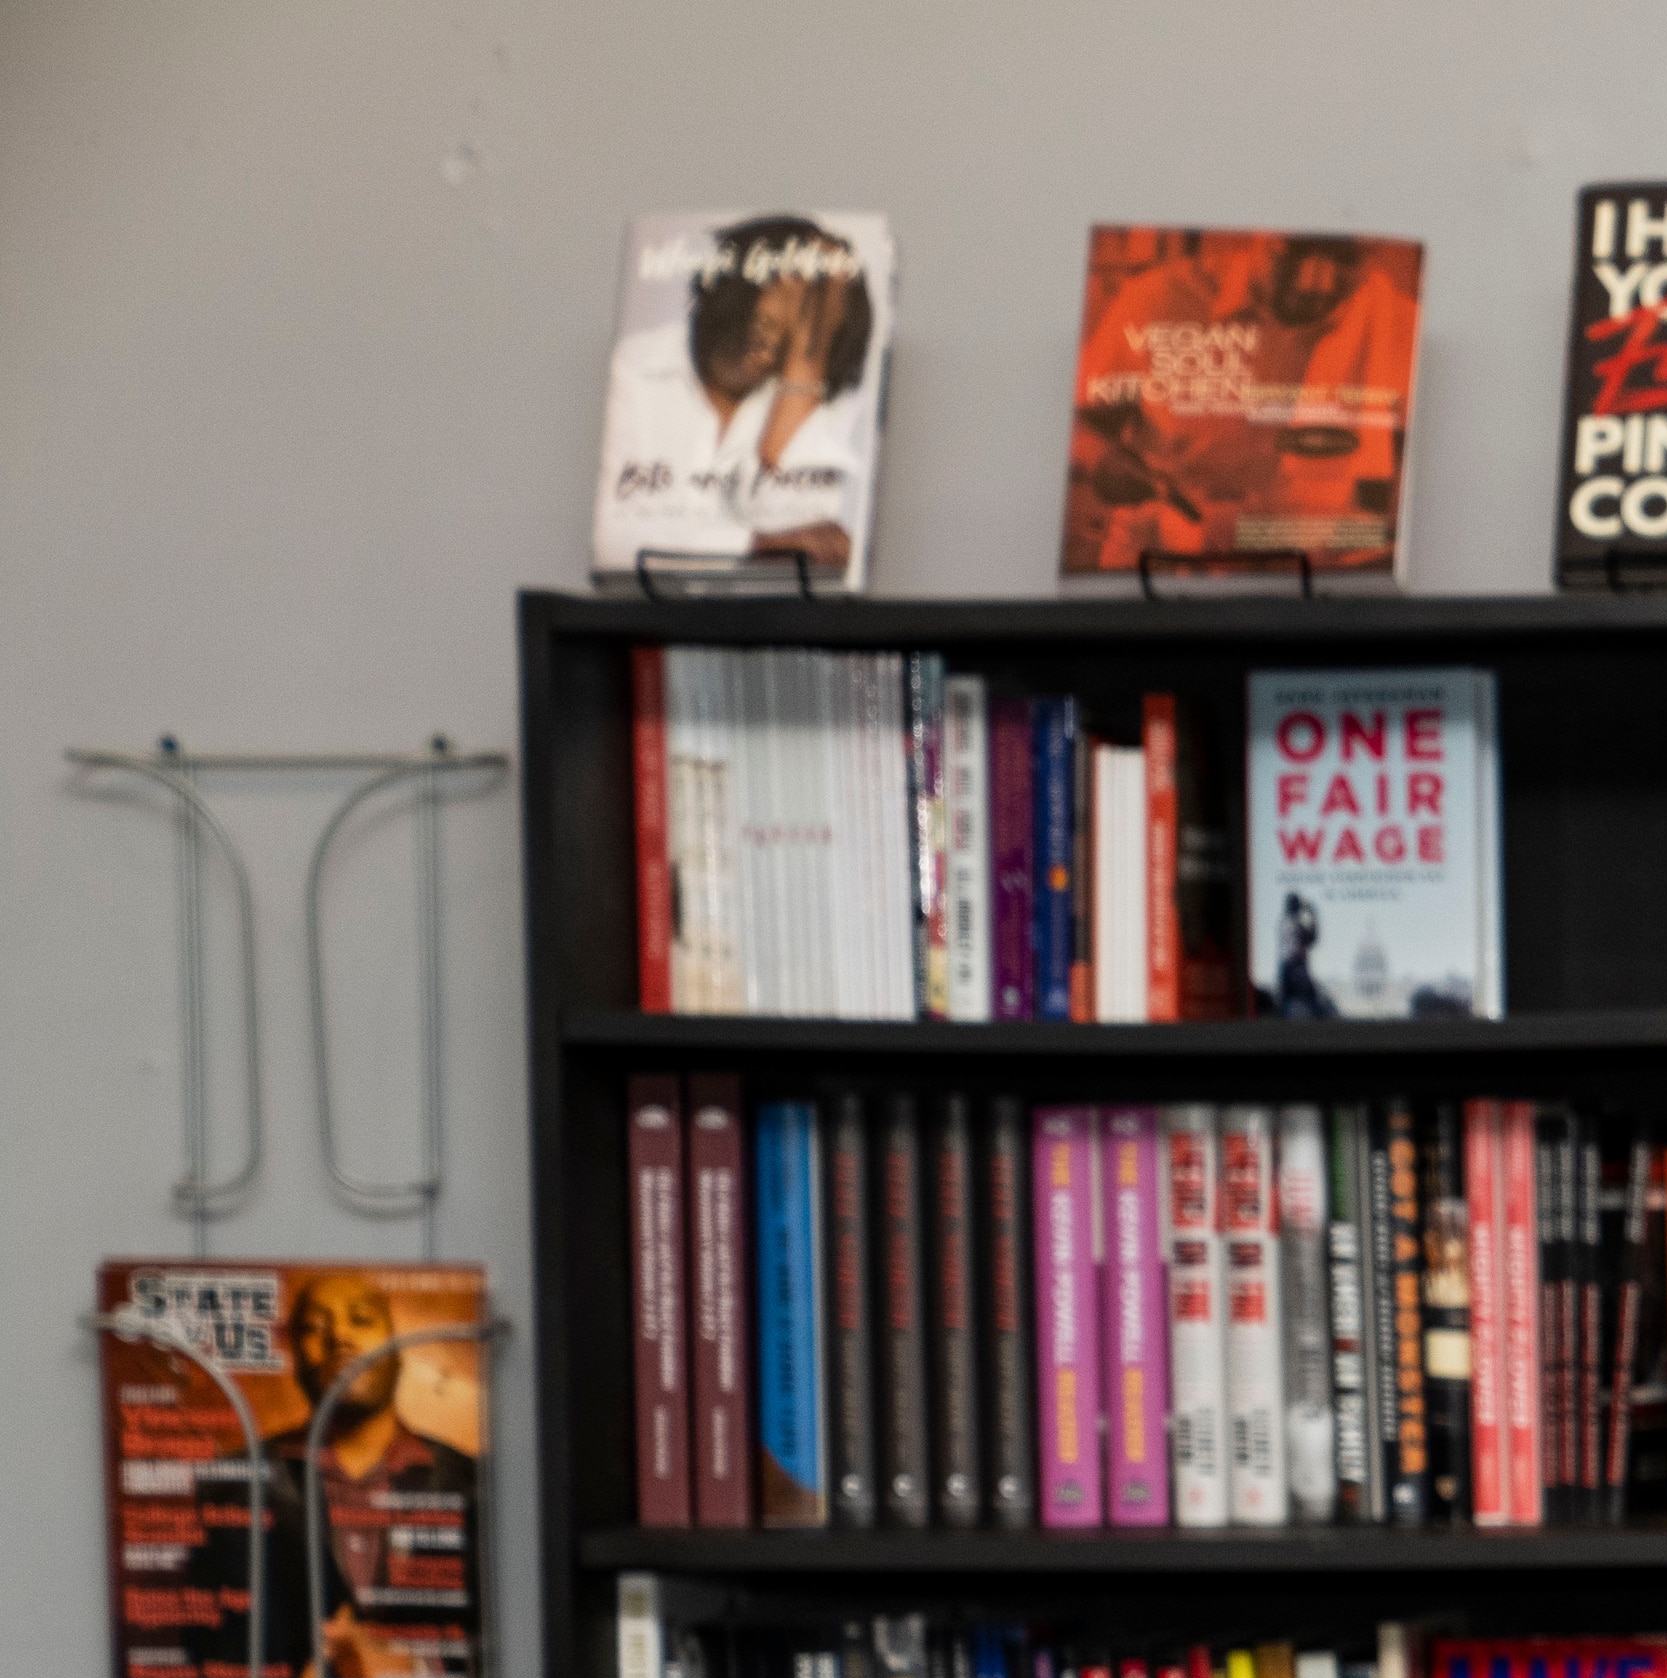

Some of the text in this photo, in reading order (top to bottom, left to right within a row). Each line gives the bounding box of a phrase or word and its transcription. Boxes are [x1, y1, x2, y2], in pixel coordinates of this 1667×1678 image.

[1592, 199, 1615, 259] I
[1124, 321, 1260, 354] VEGAN
[1150, 350, 1251, 377] SOUL
[1087, 373, 1250, 404] KITCHEN
[1276, 709, 1443, 764] ONE
[1277, 772, 1443, 818] FAIR
[1277, 826, 1443, 866] WAGE
